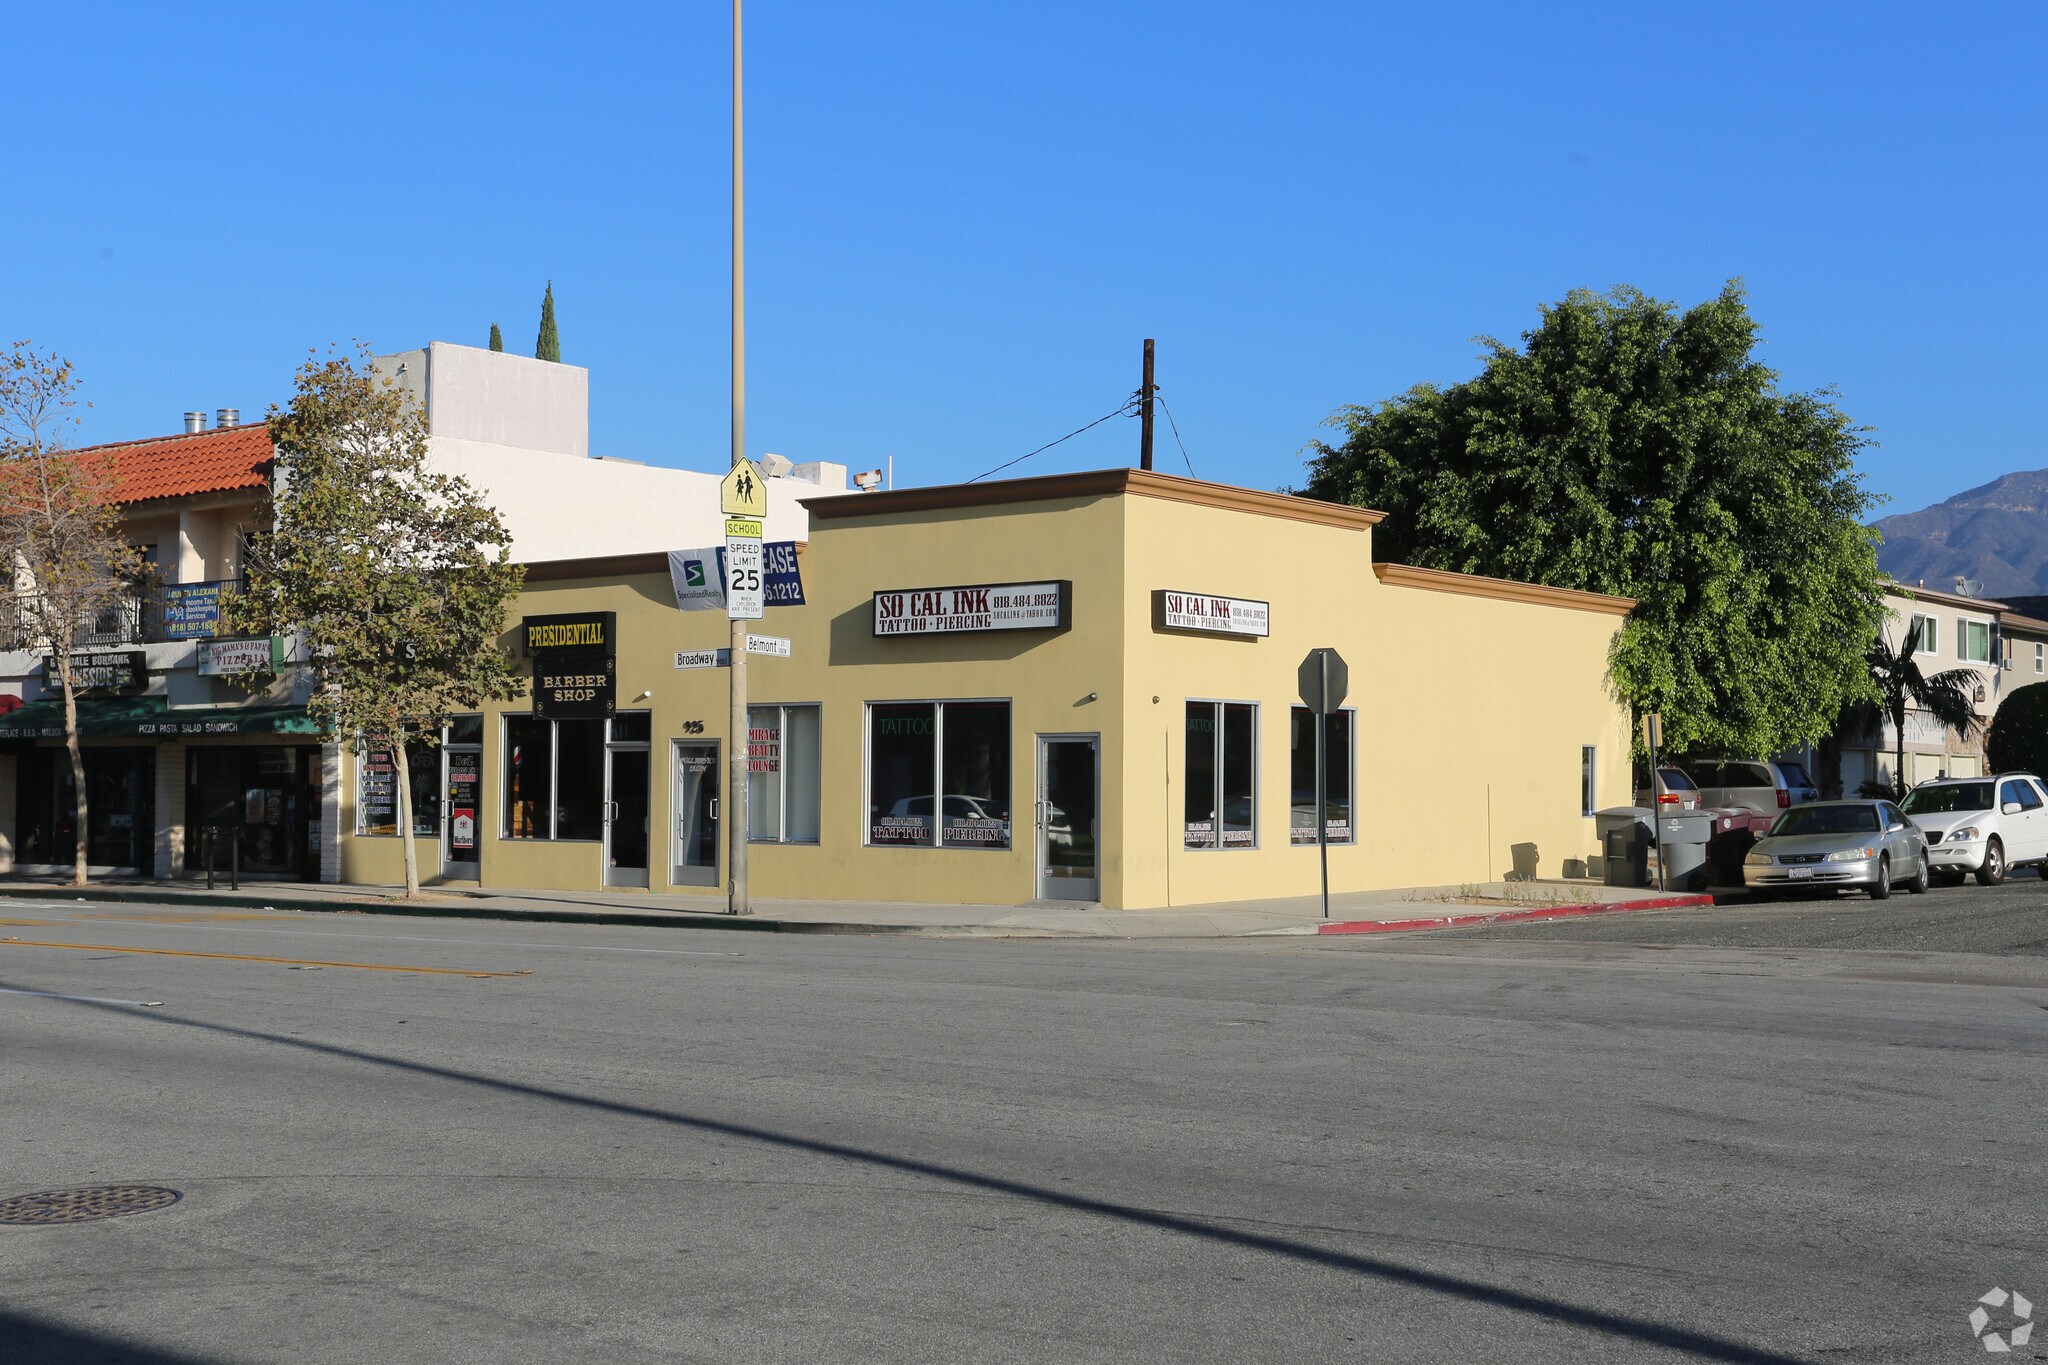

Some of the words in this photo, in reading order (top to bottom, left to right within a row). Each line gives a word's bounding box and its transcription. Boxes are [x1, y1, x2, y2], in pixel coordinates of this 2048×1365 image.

[727, 523, 760, 535] SCHOOL
[730, 543, 759, 554] SPEED
[733, 557, 757, 567] LIMIT
[761, 546, 797, 574] EASE
[731, 568, 760, 592] 25
[763, 582, 801, 601] 6.1212
[186, 605, 216, 613] Bookkeeping
[880, 594, 904, 618] SO
[910, 592, 947, 617] CAL
[952, 588, 991, 615] INK
[993, 593, 1057, 609] 818.484.8822
[1167, 594, 1182, 614] SO
[1186, 596, 1207, 616] CAL
[1210, 599, 1231, 619] INK
[879, 617, 927, 633] TATTOO
[935, 614, 992, 630] PIERCING
[1167, 613, 1196, 627] TATTOO
[1200, 616, 1232, 630] PIERCING
[528, 623, 604, 647] PRESIDENTIAL
[748, 636, 778, 653] Belmont
[677, 652, 715, 667] Broadway
[543, 675, 607, 688] BARBER
[554, 689, 596, 702] SHOP
[139, 724, 156, 733] PIZZA
[160, 724, 177, 733] PASTA
[181, 724, 202, 732] SALAD
[205, 723, 238, 732] SANDWICH
[682, 720, 704, 735] 925
[748, 728, 780, 741] MIRAGE
[748, 744, 780, 757] BEAUTY
[748, 759, 780, 773] LOUNGE
[873, 827, 929, 839] TATTOO
[944, 829, 1004, 841] PIERCING
